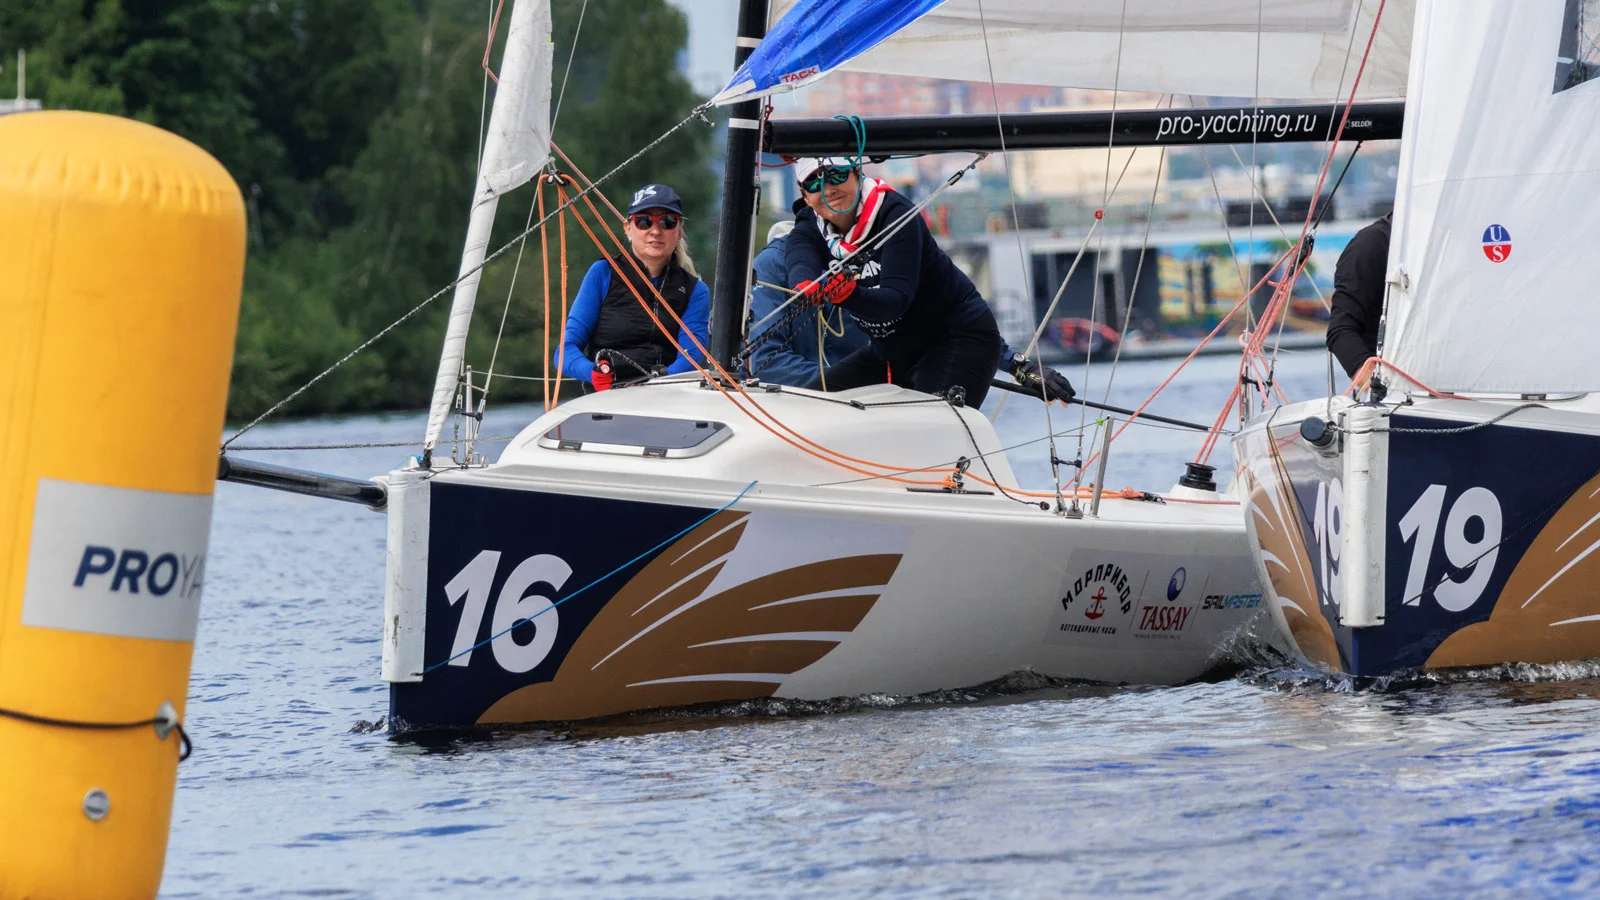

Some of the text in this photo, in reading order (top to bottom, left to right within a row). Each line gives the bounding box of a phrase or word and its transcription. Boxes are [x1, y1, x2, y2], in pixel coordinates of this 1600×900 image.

[782, 66, 818, 83] TACK
[1155, 109, 1317, 141] pro-yachting.ru
[1398, 483, 1503, 613] 19
[1061, 563, 1132, 615] МОРПРИБОР
[444, 549, 573, 674] 16
[1139, 606, 1193, 631] TASSAY
